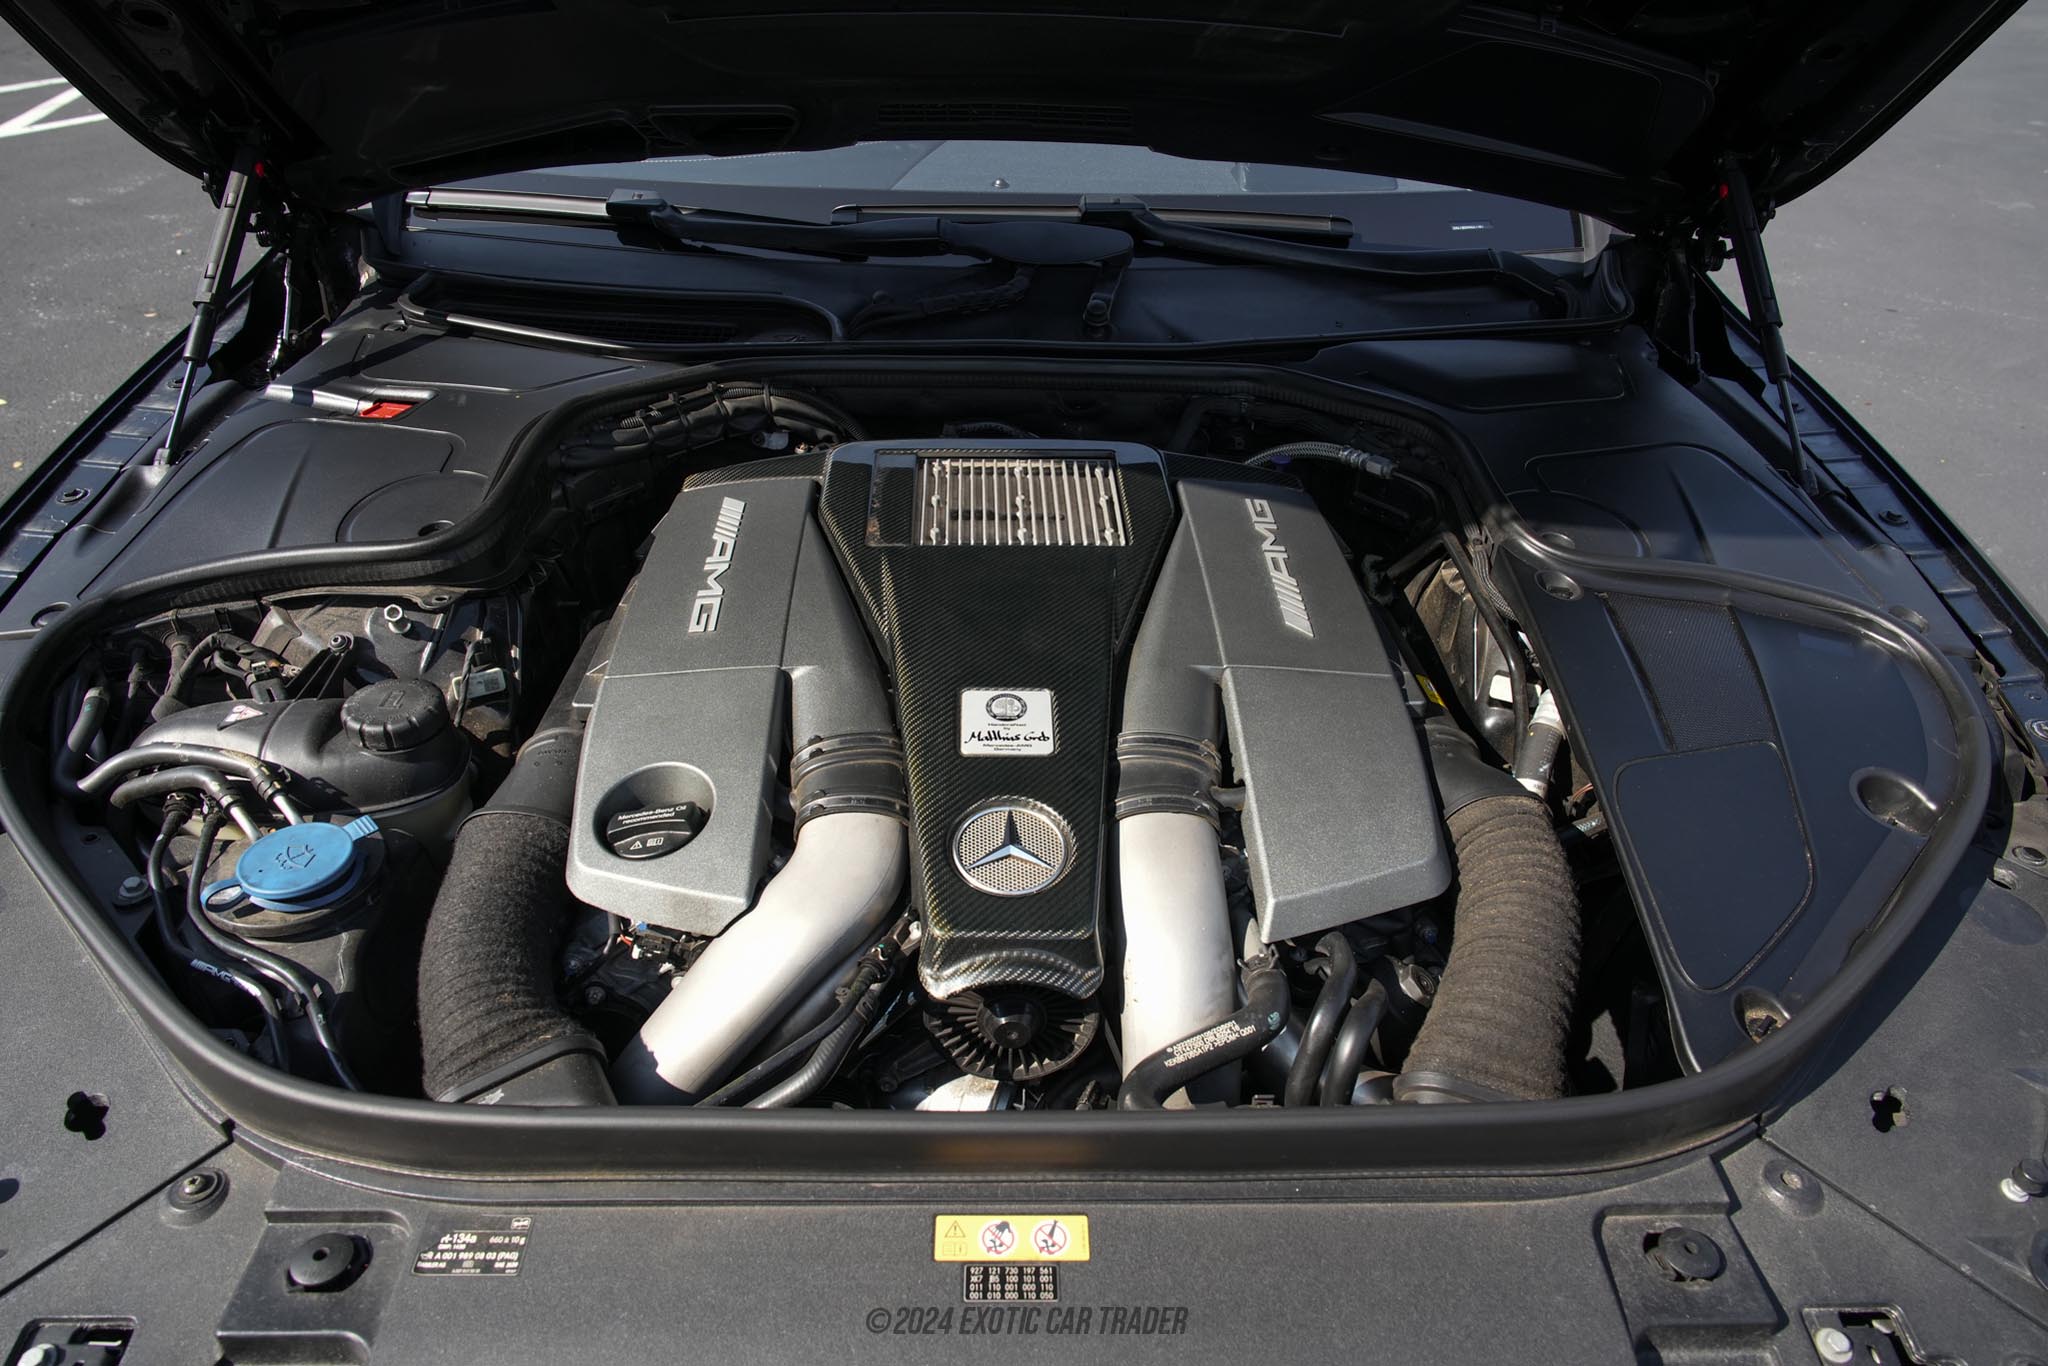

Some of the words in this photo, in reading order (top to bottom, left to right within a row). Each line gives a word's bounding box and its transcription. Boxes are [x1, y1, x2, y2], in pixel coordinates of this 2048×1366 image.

[1245, 498, 1298, 587] AMG
[689, 533, 737, 632] AMG
[618, 807, 674, 820] Mercedes-Benz
[623, 812, 675, 824] recommended
[1006, 1275, 1018, 1283] 100
[1023, 1275, 1035, 1283] 101
[1039, 1275, 1052, 1283] 001
[969, 1283, 982, 1291] 011
[989, 1283, 1001, 1291] 110
[1005, 1283, 1018, 1291] 001
[1022, 1283, 1036, 1291] 000
[1041, 1283, 1053, 1291] 110
